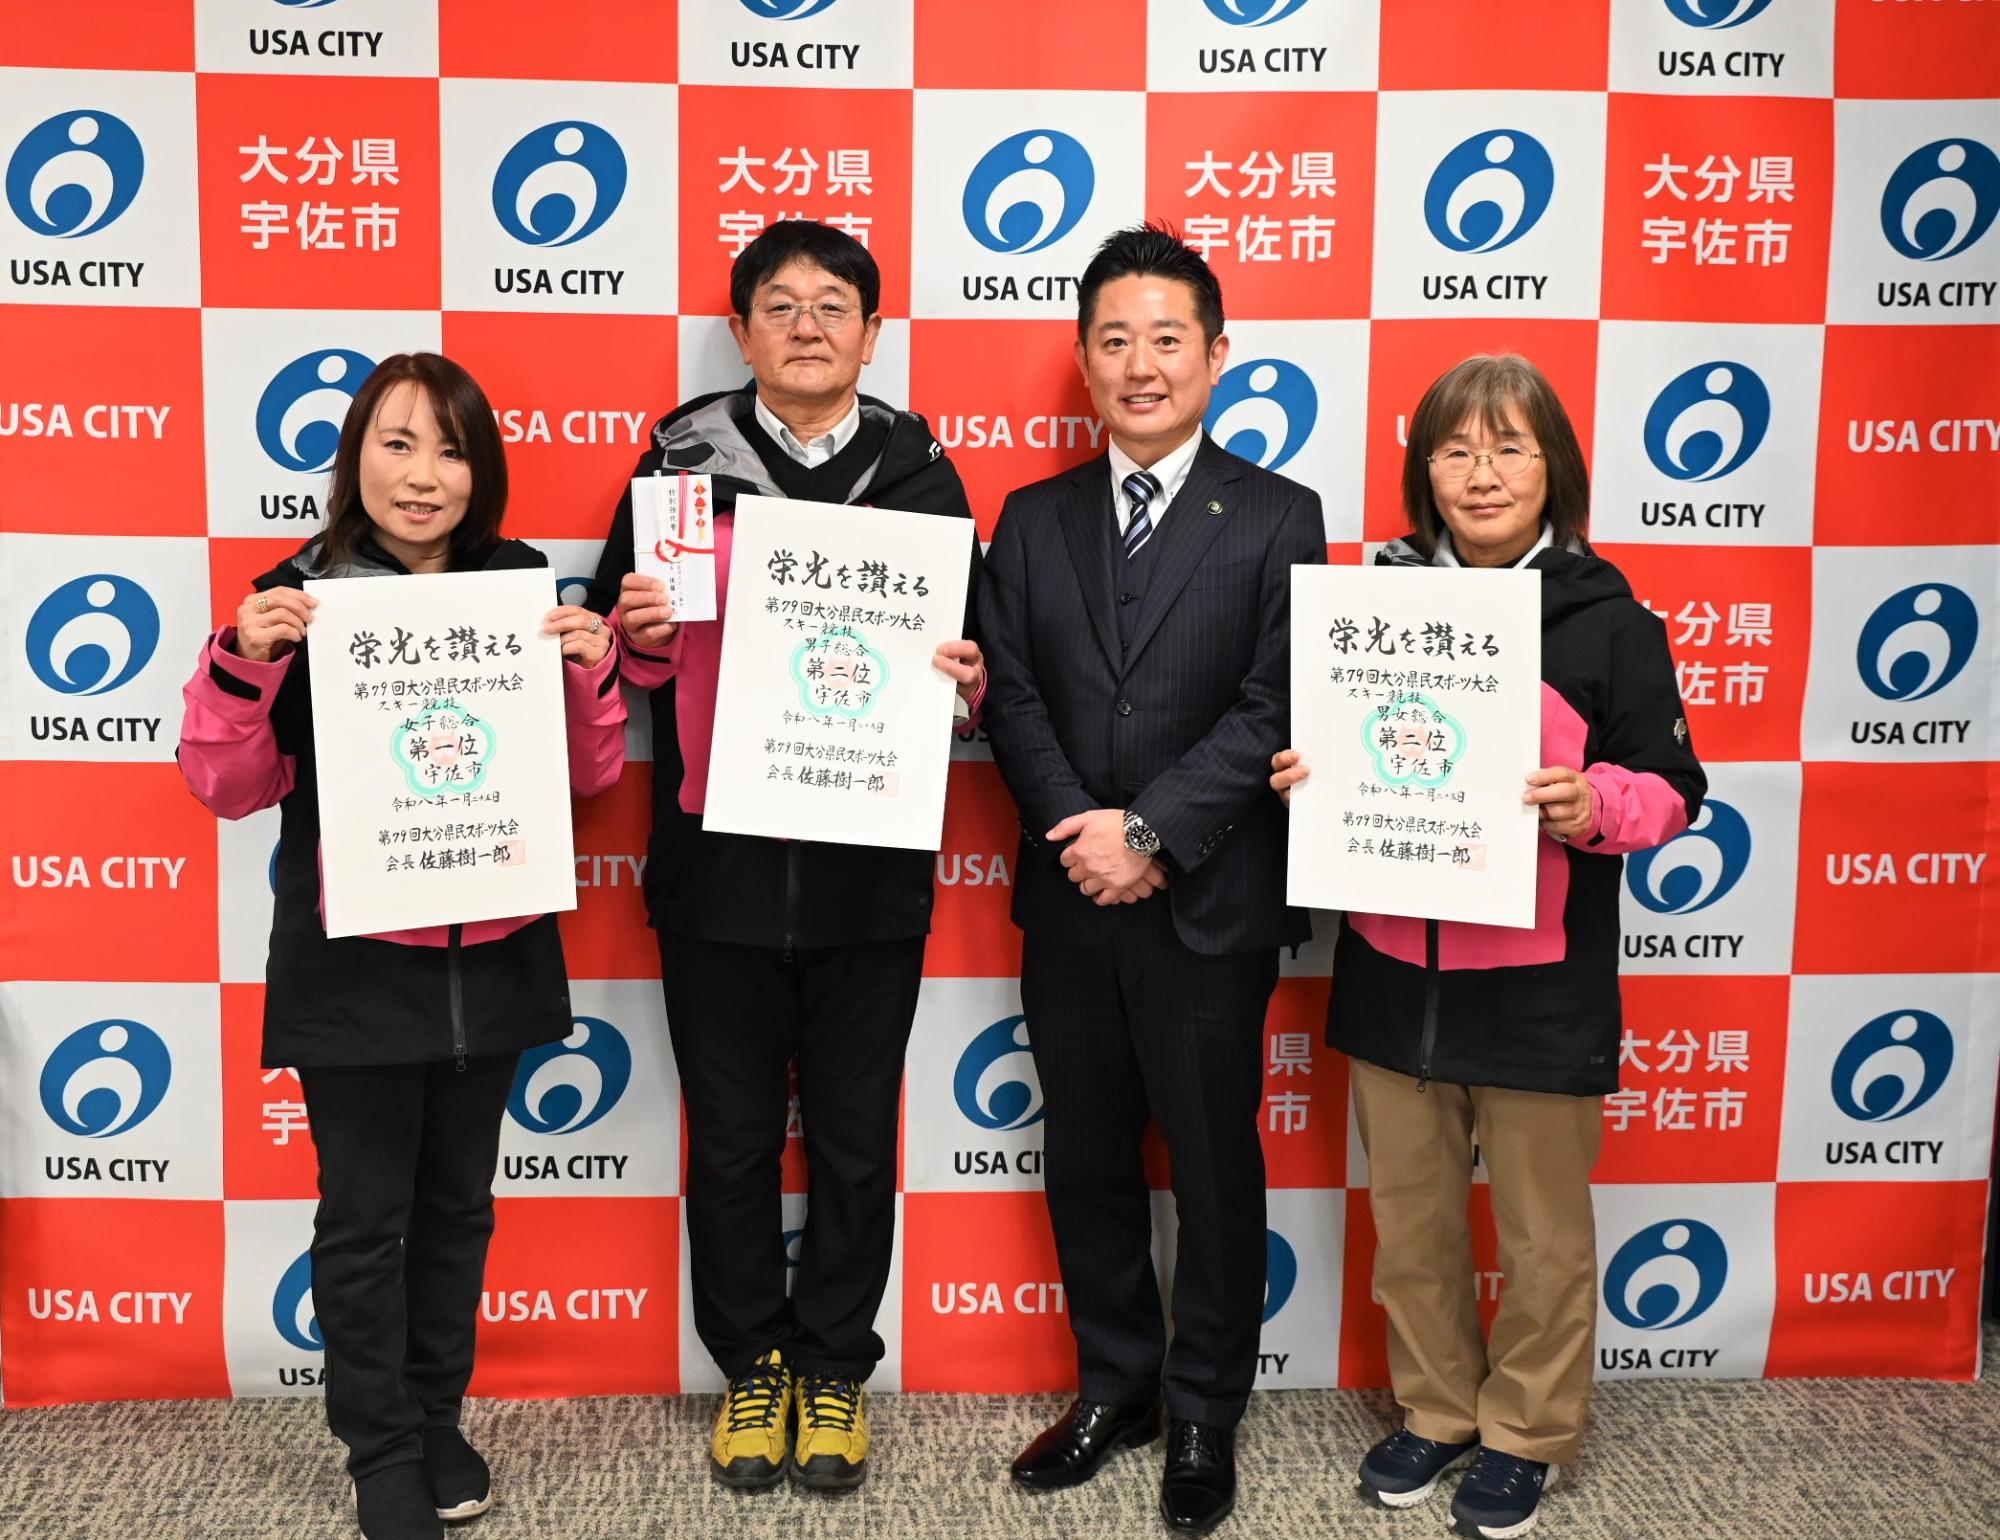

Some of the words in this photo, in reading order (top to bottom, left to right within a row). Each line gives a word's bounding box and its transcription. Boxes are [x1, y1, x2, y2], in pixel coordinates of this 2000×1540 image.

[249, 29, 308, 56] USA
[317, 31, 383, 57] CITY
[731, 42, 788, 68] USA
[796, 43, 860, 70] CITY
[1198, 48, 1257, 74] USA
[1264, 47, 1327, 73] CITY
[1657, 50, 1716, 76] USA
[1725, 51, 1785, 78] CITY
[238, 135, 400, 187] 大分県
[718, 146, 873, 197] 大分県
[1184, 150, 1337, 199] 大分県
[1643, 153, 1796, 204] 大分県
[239, 200, 400, 251] 宇佐市
[1183, 214, 1336, 263] 宇佐市
[1641, 217, 1793, 267] 宇佐市
[10, 260, 72, 287] USA
[79, 261, 145, 288] CITY
[494, 268, 553, 294] USA
[561, 269, 625, 296] CITY
[1422, 275, 1479, 300] USA
[1486, 275, 1548, 300] CITY
[963, 276, 1019, 301] USA
[1878, 282, 1931, 307] USA
[1938, 282, 1997, 307] CITY
[0, 403, 73, 437] USA
[84, 404, 170, 439] CITY
[493, 409, 552, 443] SA
[562, 410, 647, 444] CITY
[939, 415, 1014, 448] USA
[1024, 415, 1105, 449] CITY
[1848, 420, 1920, 453] USA
[1929, 419, 2000, 452] CITY
[260, 494, 319, 520] USA
[1641, 502, 1697, 527] USA
[1705, 503, 1765, 529] CITY
[1642, 600, 1773, 647] 分県
[806, 657, 871, 685] 第二位
[815, 684, 872, 708] 宇佐市
[30, 716, 90, 742] USA
[96, 717, 162, 743] CITY
[1379, 726, 1447, 752] 第二位
[1850, 721, 1905, 745] USA
[1913, 720, 1971, 744] CITY
[409, 733, 479, 762] 第一位
[424, 761, 482, 784] 宇佐市
[1390, 754, 1454, 777] 宇佐市
[12, 856, 91, 888] USA
[101, 857, 187, 889] CITY
[937, 854, 1010, 886] USA
[1826, 853, 1897, 885] USA
[1907, 852, 1987, 883] CITY
[1624, 935, 1677, 958] USA
[1684, 935, 1744, 958] CITY
[1619, 1029, 1750, 1073] 大分県
[1603, 1088, 1747, 1131] 宇佐市
[504, 1154, 560, 1180] USA
[566, 1154, 628, 1180] CITY
[954, 1151, 1008, 1174] USA
[1825, 1142, 1878, 1165] USA
[1885, 1141, 1944, 1165] CITY
[45, 1156, 102, 1182] USA
[109, 1158, 171, 1183] CITY
[931, 1282, 1004, 1314] USA
[1804, 1273, 1872, 1303] USA
[1882, 1269, 1955, 1300] CITY
[28, 1288, 100, 1322] USA
[109, 1290, 193, 1324] CITY
[480, 1290, 555, 1323] USA
[566, 1288, 648, 1320] CITY
[1600, 1348, 1652, 1371] USA
[1660, 1349, 1719, 1370] CITY
